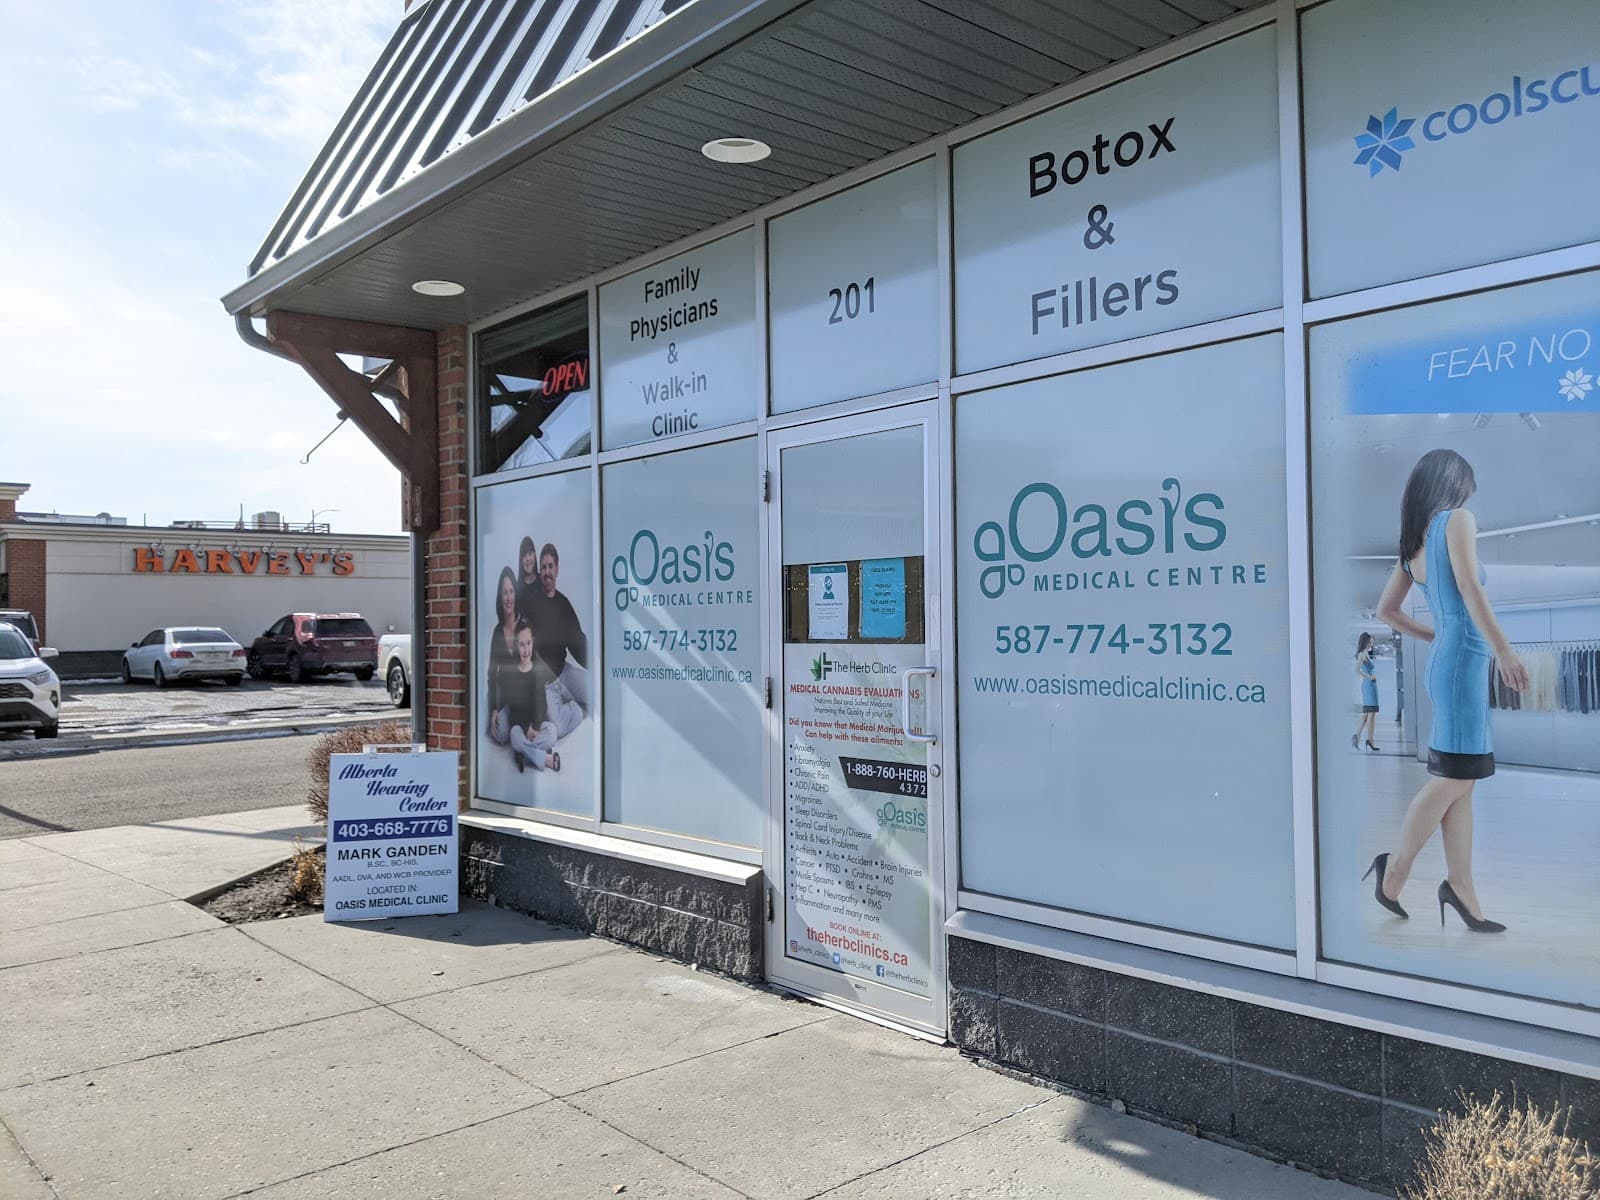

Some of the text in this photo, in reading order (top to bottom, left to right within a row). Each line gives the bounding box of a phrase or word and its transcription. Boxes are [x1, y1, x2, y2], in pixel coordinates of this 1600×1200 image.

[1030, 117, 1176, 198] Botox
[1083, 204, 1115, 250] &
[644, 266, 700, 303] Family
[829, 276, 874, 325] 201
[1031, 270, 1179, 335] Fillers
[630, 298, 718, 341] Physicians
[667, 342, 679, 364] &
[1428, 329, 1591, 382] FEAR NO
[542, 359, 588, 396] OPEN
[642, 371, 707, 406] Walk-in
[652, 409, 698, 437] Clinic
[1009, 478, 1227, 562] Oasis
[133, 547, 354, 575] HARVEY'S
[630, 530, 735, 585] Oasis
[1033, 564, 1267, 592] MEDICAL CENTRE
[642, 590, 753, 607] MEDICAL CENTRE
[623, 629, 737, 651] 587-774-3132
[995, 622, 1233, 656] 587-774-3132
[611, 665, 753, 683] www.oasismedicalclinic.ca
[833, 661, 897, 674] The Herb Clinic
[790, 684, 920, 699] MEDICAL CANNABIS EVALUATINS
[973, 674, 1267, 703] www.oasismedicalclinic.ca
[814, 707, 837, 717] Improving
[838, 707, 846, 715] the
[846, 708, 864, 718] Quality
[865, 708, 871, 716] of
[871, 710, 883, 719] your
[843, 698, 853, 706] and
[869, 700, 893, 708] Medicine
[789, 718, 800, 726] Did
[801, 719, 813, 729] you
[814, 719, 833, 728] know
[834, 720, 848, 730] that
[849, 722, 876, 732] Medical
[794, 743, 815, 754] Anxiety
[805, 730, 903, 746] Can help with these ailments:
[338, 763, 398, 781] Alberta
[794, 767, 830, 780] Chronic Pain
[846, 762, 927, 784] 1-888-760-HERB
[366, 780, 430, 797] Hearing
[794, 781, 830, 793] ADD/ADHD
[399, 797, 448, 812] Center
[794, 794, 822, 806] Migraines
[794, 805, 838, 821] Sleep Disorders
[883, 801, 926, 826] Oasis
[338, 819, 449, 838] 403-668-7776
[794, 818, 872, 840] Spinal Cord Injury/Disease
[338, 844, 448, 860] MARK GANDEN
[794, 832, 809, 842] Back
[815, 835, 831, 846] Neck
[831, 837, 859, 851] Problems
[825, 850, 839, 860] Auto
[846, 854, 873, 867] Accident
[880, 860, 898, 873] Brain
[393, 870, 412, 878] WCB
[413, 869, 452, 877] PROVIDER
[825, 862, 841, 874] PTSD
[851, 868, 874, 881] Crohns
[883, 875, 894, 886] MS
[367, 885, 406, 895] LOCATED
[795, 883, 808, 895] Hep
[823, 888, 858, 906] Neuropathy
[868, 899, 882, 910] PMS
[812, 873, 834, 886] Spasms
[845, 879, 855, 891] IBS
[866, 885, 892, 900] Epilepsy
[335, 894, 449, 910] OASIS MEDICAL CLINIC
[832, 904, 844, 914] and
[845, 909, 862, 920] many
[863, 913, 880, 923] more
[829, 921, 882, 941] BOOK ONLINE AT:
[806, 926, 909, 967] theherbclinics.ca
